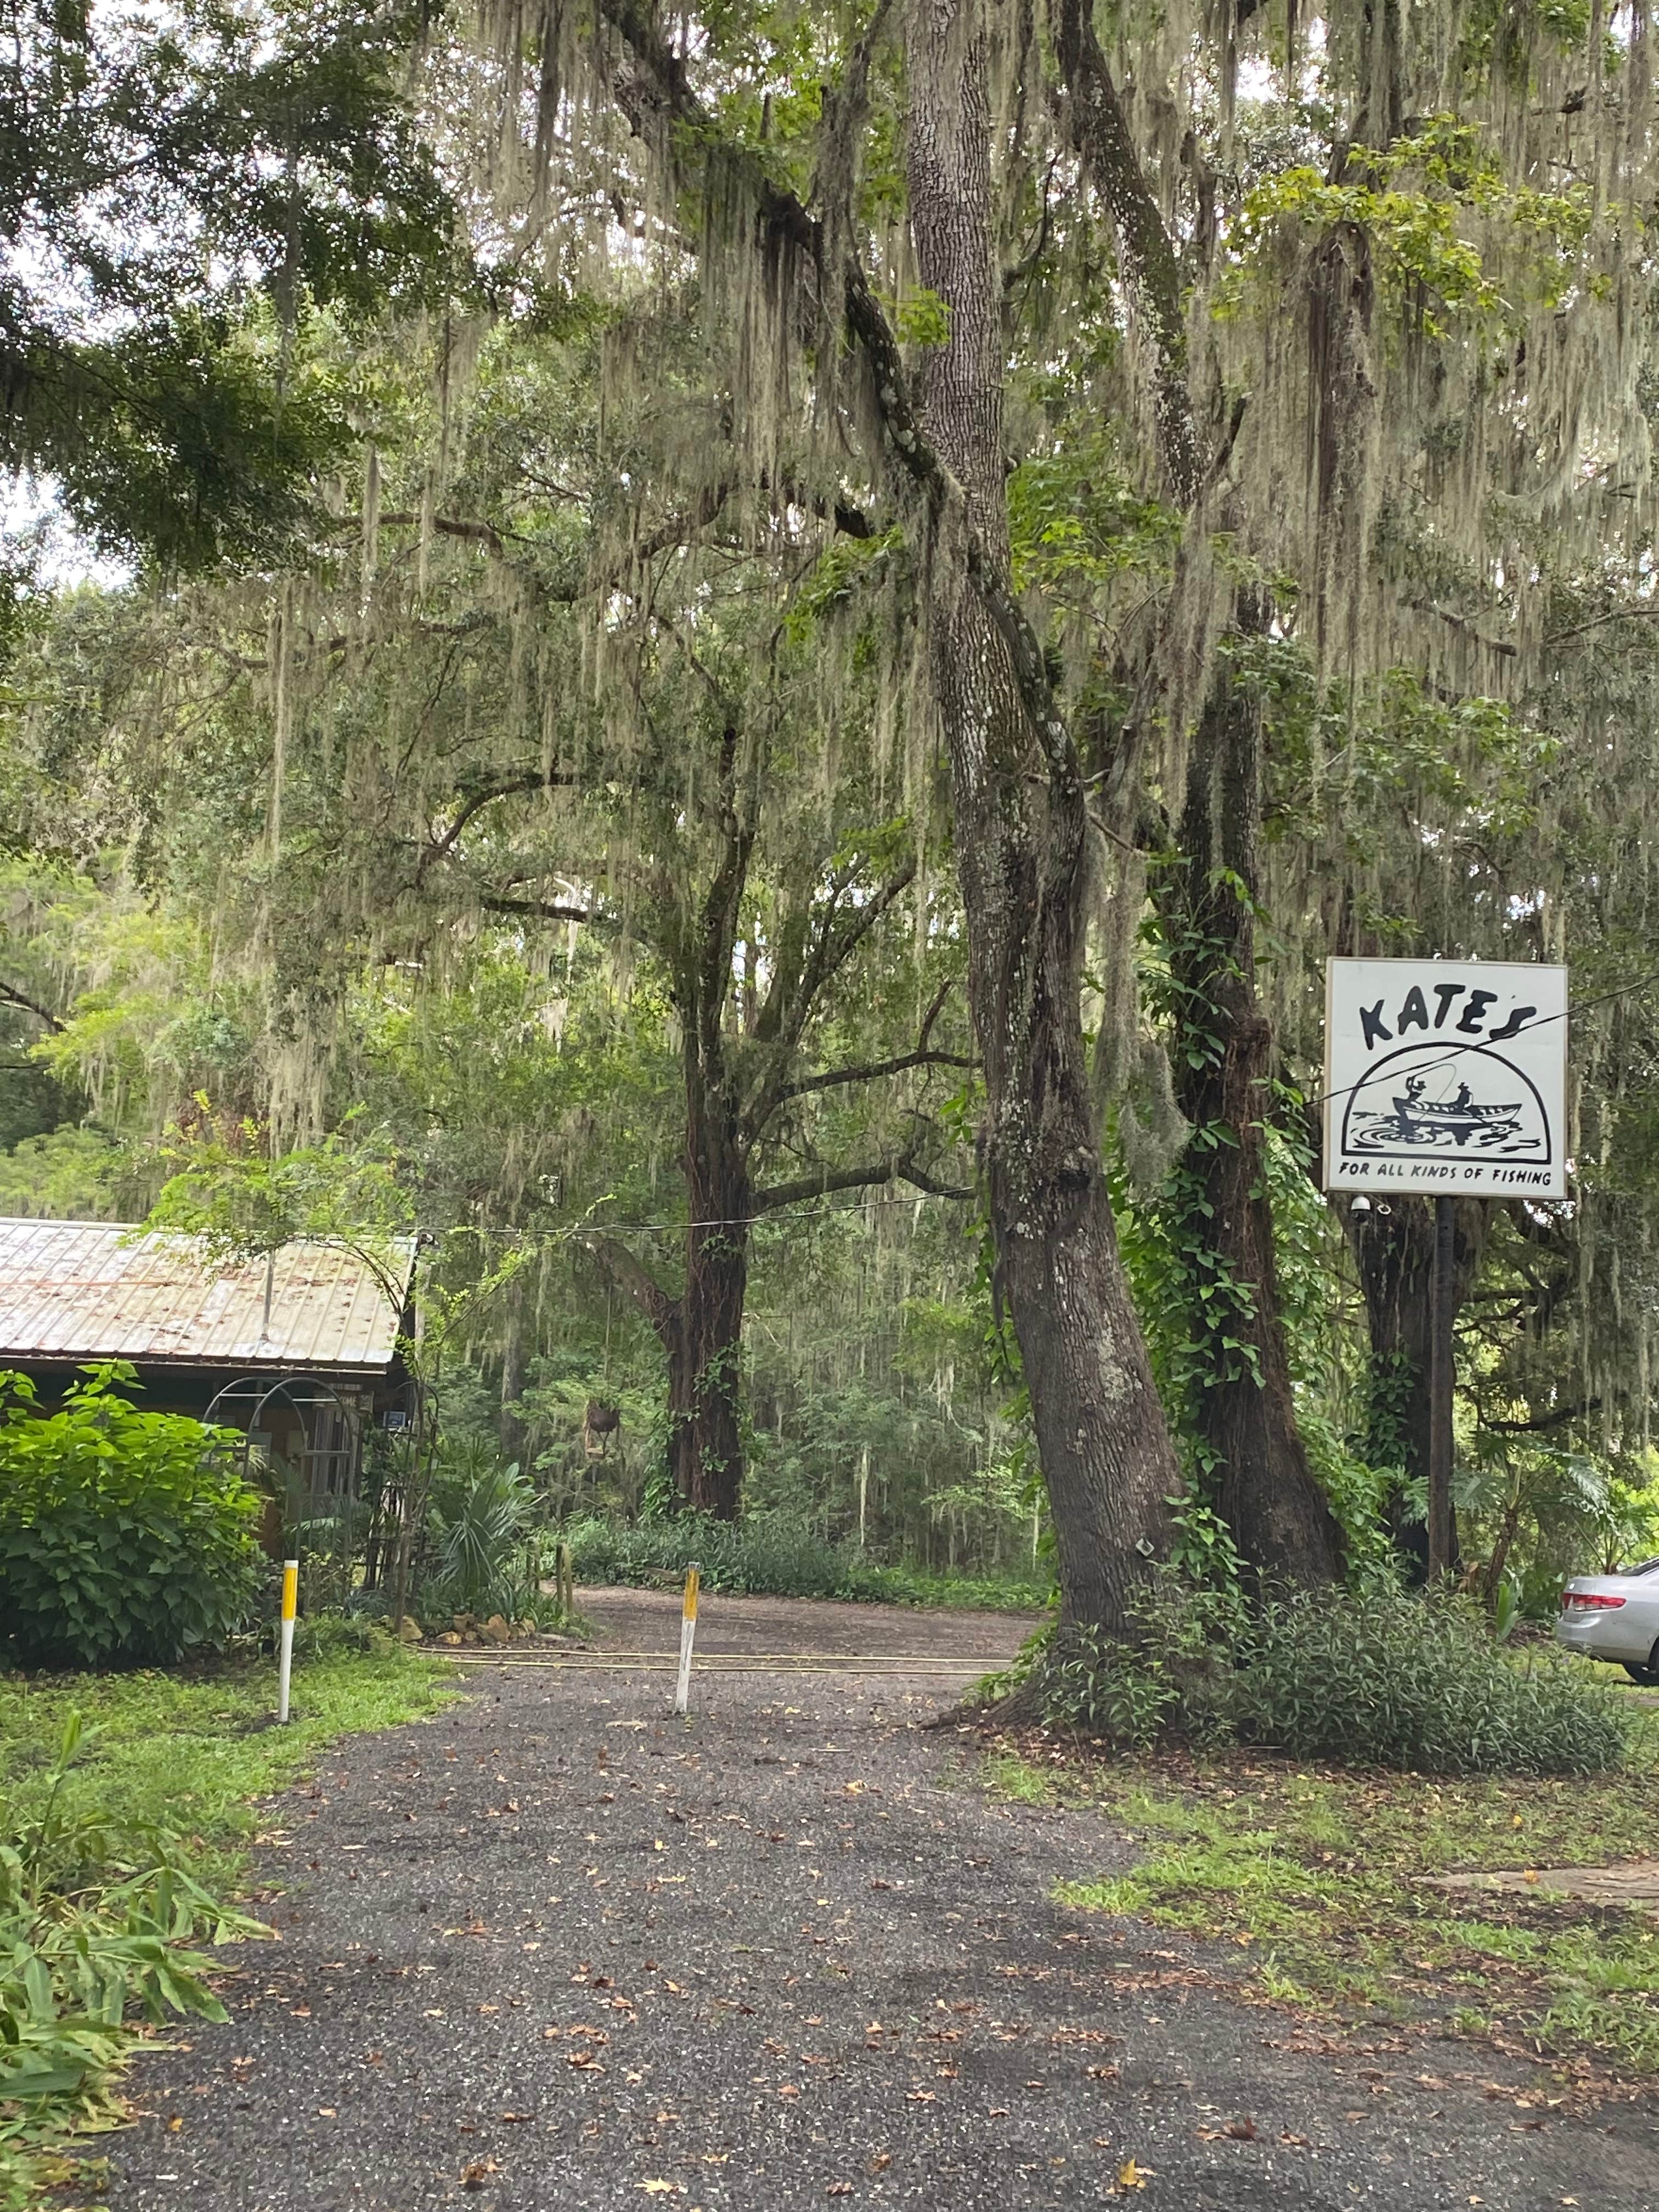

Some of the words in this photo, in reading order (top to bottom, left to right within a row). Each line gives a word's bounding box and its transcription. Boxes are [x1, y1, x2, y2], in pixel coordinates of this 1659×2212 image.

[1359, 984, 1537, 1051] KATE'S
[1339, 1162, 1370, 1176] FOR
[1377, 1163, 1404, 1176] ALL
[1410, 1164, 1457, 1179] KINDS
[1464, 1167, 1484, 1180] OF
[1492, 1169, 1551, 1186] FISHING
